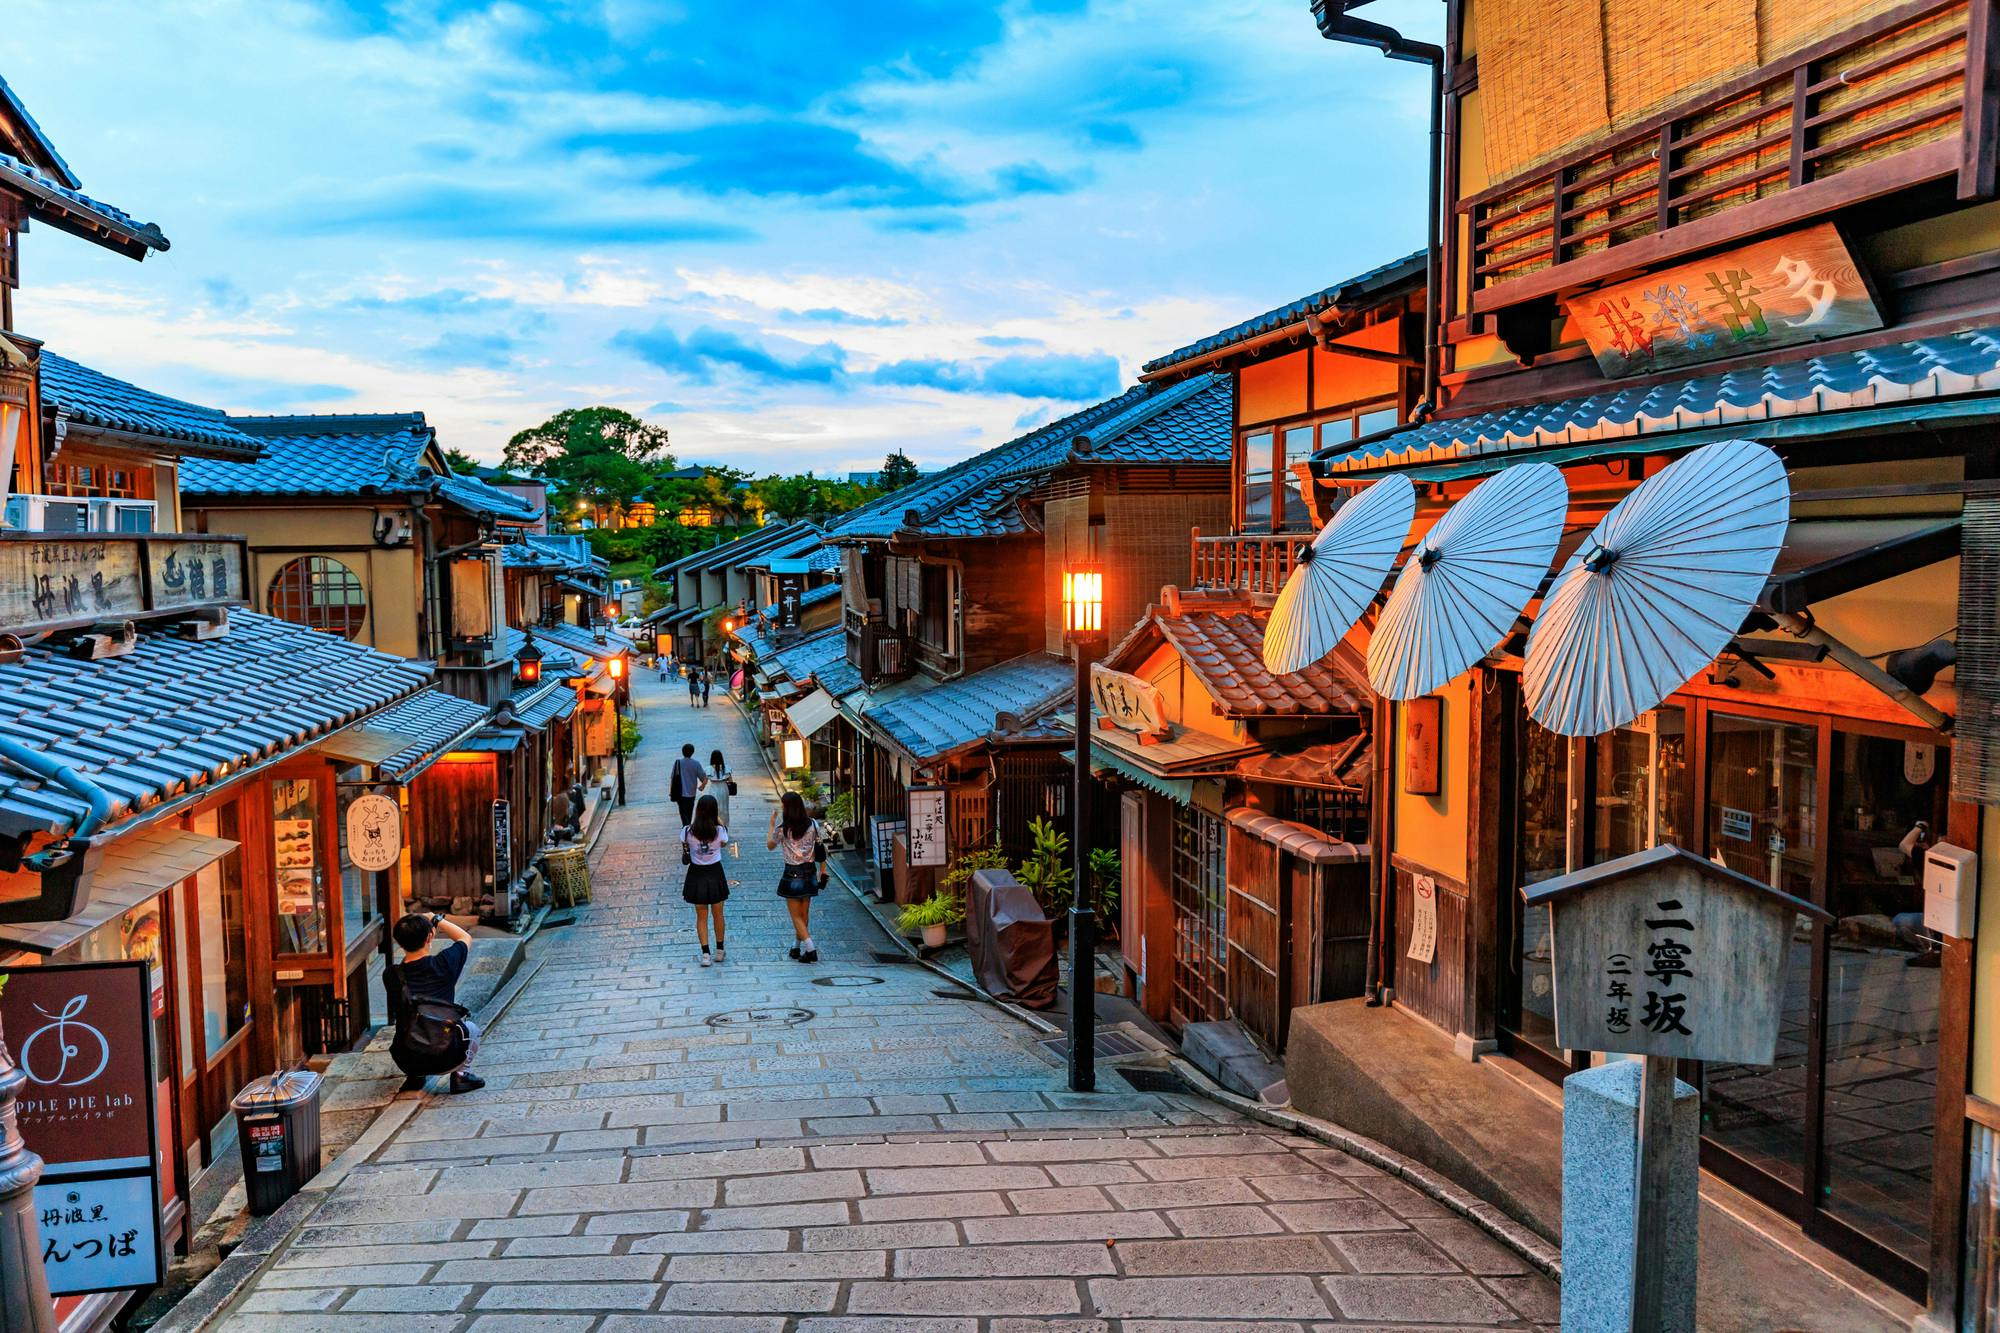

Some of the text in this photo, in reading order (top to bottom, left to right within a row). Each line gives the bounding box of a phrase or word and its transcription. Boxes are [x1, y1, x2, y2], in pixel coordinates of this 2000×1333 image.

[912, 829, 925, 859] ふたば
[1640, 899, 1695, 1036] 二寧坂
[15, 1094, 133, 1113] PPLE PIE lab
[41, 1204, 108, 1227] 丹波黒
[43, 1229, 139, 1264] んつば
